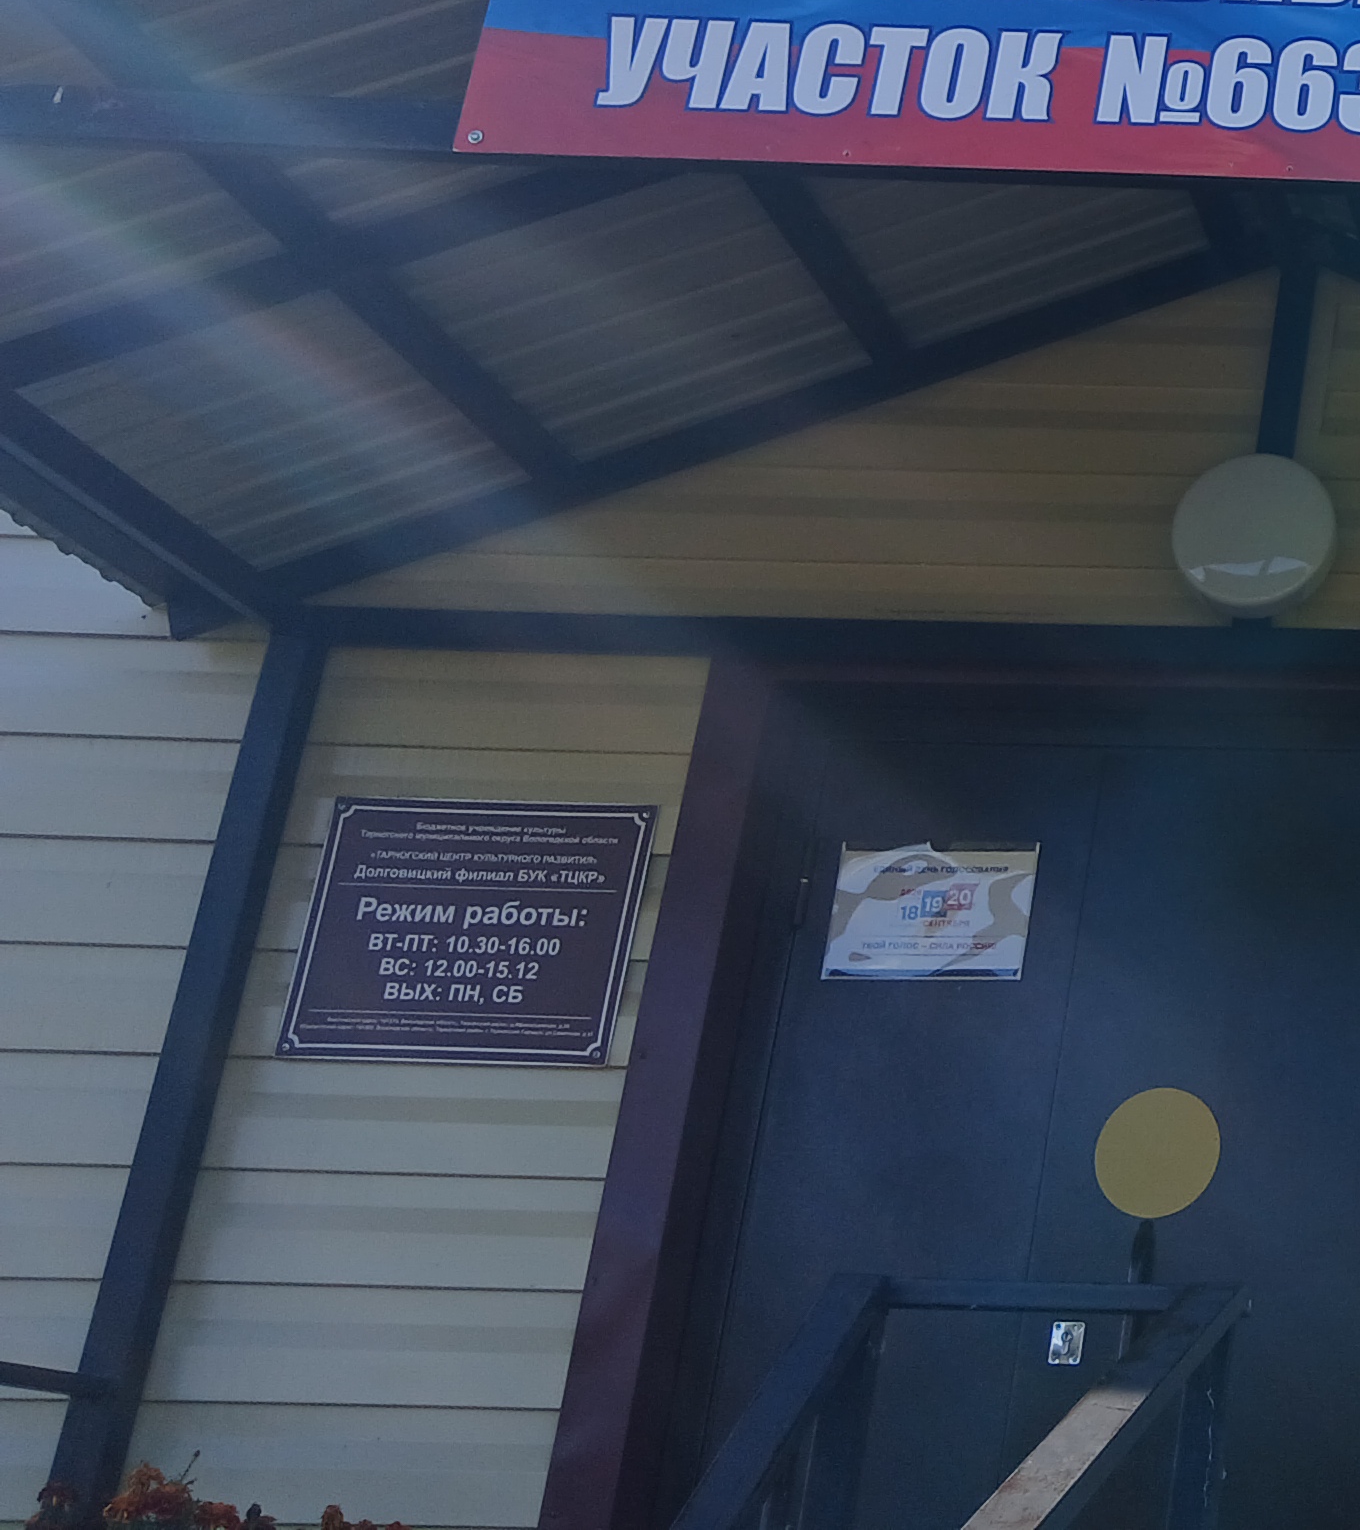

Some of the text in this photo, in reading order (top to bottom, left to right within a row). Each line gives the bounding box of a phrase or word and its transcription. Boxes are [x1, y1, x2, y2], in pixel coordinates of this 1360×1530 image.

[594, 13, 1069, 122] УЧАСТОК
[354, 863, 606, 885] Долговицкий филиал БУК «ТЦКР»
[356, 896, 589, 930] Режим работы:
[900, 889, 972, 921] 18 19 20
[368, 933, 561, 957] ВТ-ПТ: 10.30-16.00
[378, 957, 540, 981] ВС: 12.00-15.12
[383, 982, 524, 1006] ВЫХ: ПН, СБ
